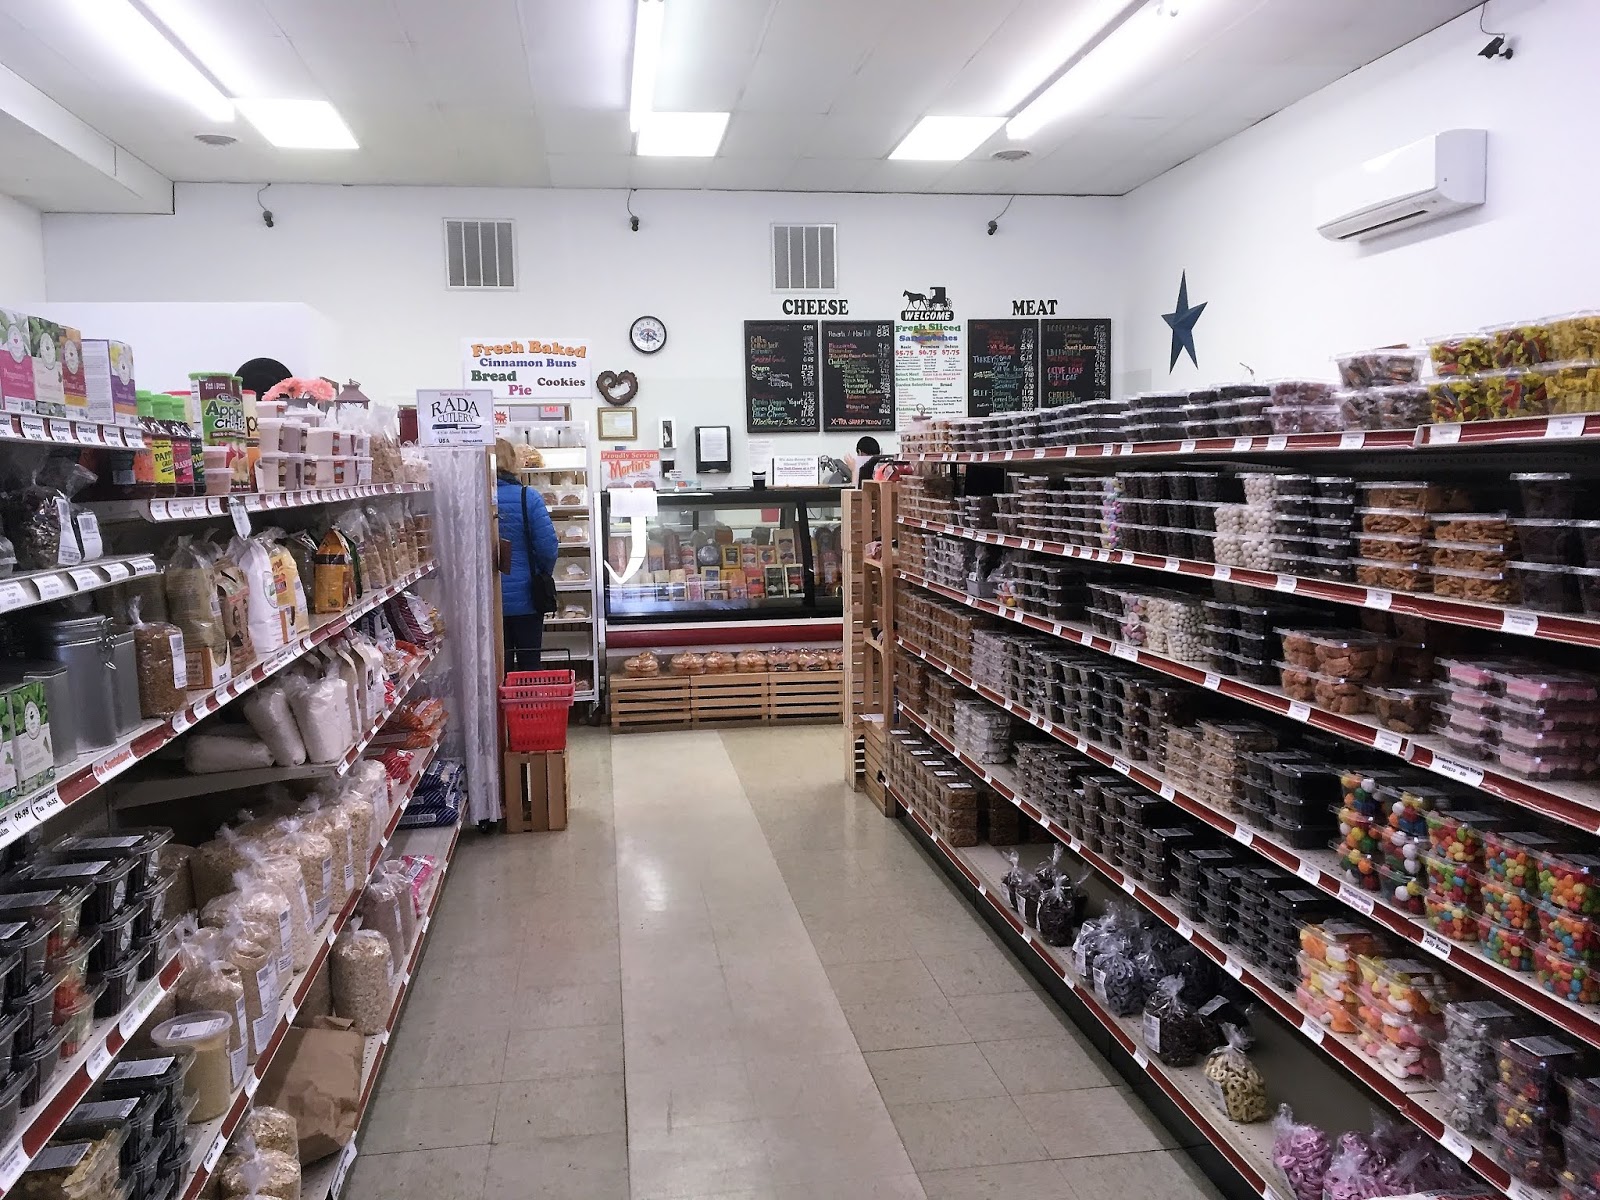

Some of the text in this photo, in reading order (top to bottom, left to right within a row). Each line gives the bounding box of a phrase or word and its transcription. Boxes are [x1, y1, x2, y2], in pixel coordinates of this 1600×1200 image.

[782, 299, 849, 315] CHEESE
[1012, 299, 1058, 316] MEAT
[904, 311, 951, 321] WELCOME
[895, 323, 962, 332] Fresh Sliced
[899, 334, 958, 342] Sandwiches
[471, 340, 587, 359] Fresh Baked
[480, 358, 577, 367] Cinnamon Buns
[471, 370, 518, 382] Bread
[537, 377, 586, 387] Cookies
[508, 384, 532, 396] Pie
[431, 397, 480, 418] RADA
[437, 412, 474, 423] CUTLERY
[602, 452, 658, 460] Proudly Serving
[609, 459, 651, 481] Martin's
